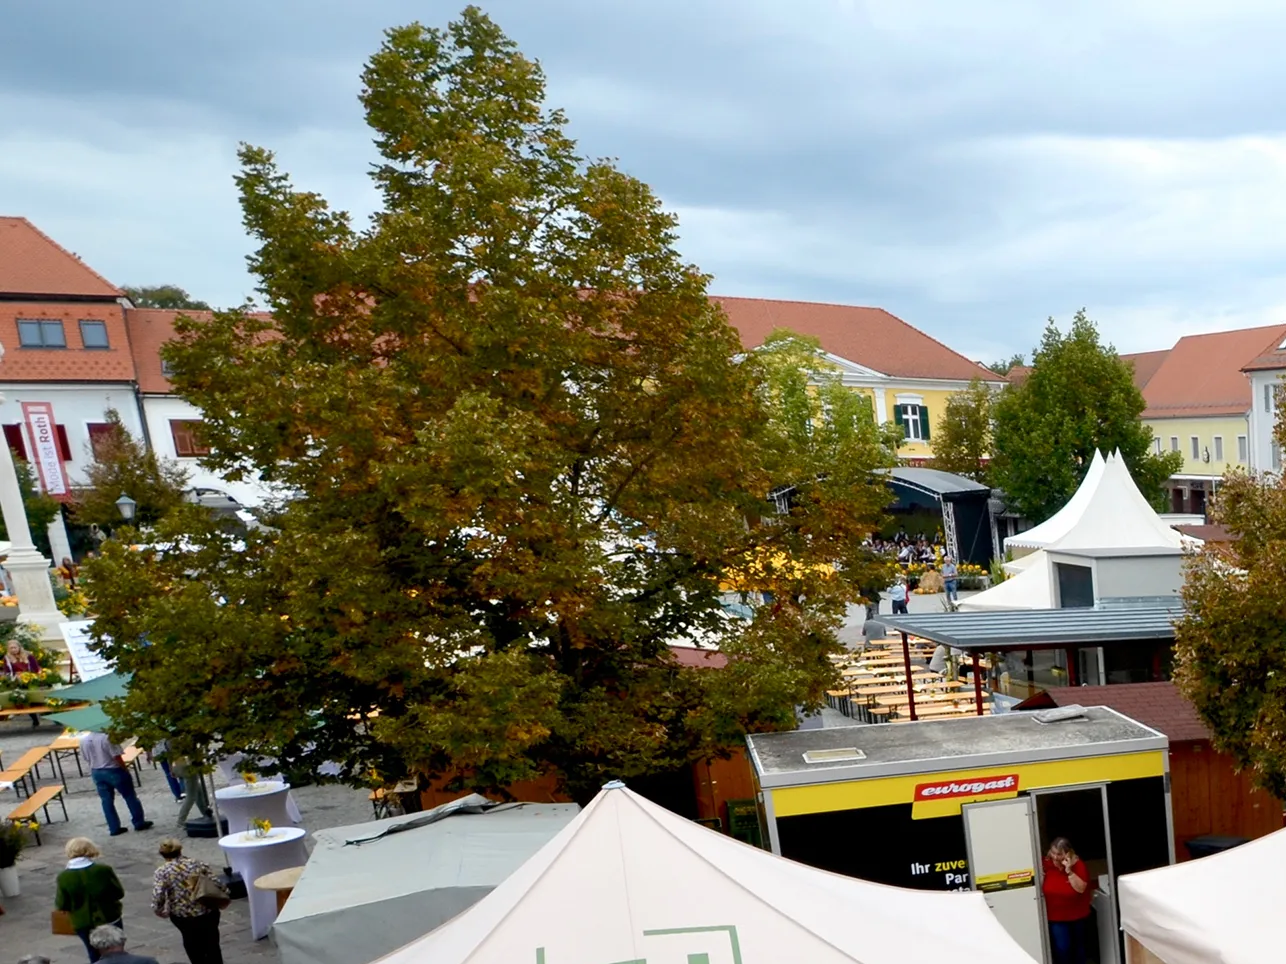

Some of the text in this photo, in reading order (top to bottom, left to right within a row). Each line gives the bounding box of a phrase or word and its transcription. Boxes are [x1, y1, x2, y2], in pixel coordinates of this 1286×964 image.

[34, 416, 50, 443] Roth
[910, 859, 967, 875] Ihr zuve
